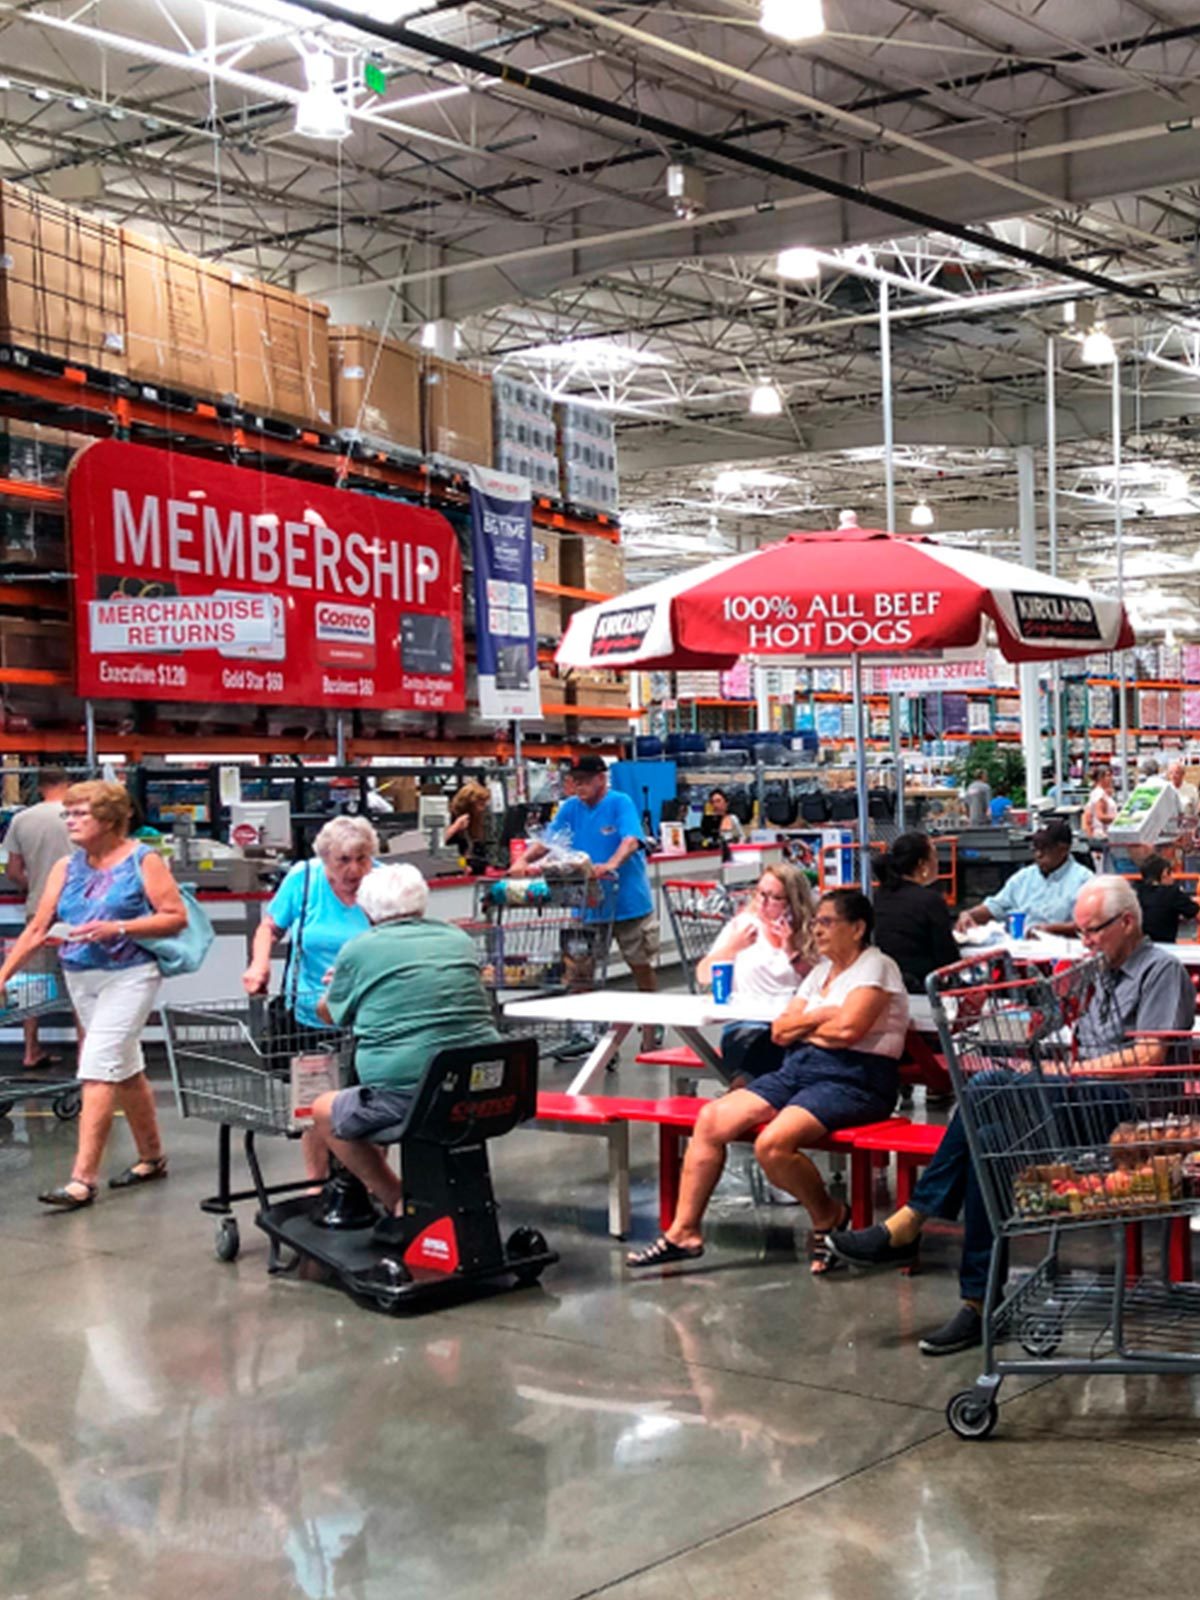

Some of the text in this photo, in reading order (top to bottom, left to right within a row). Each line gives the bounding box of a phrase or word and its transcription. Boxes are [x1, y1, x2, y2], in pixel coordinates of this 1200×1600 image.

[112, 488, 440, 605] MEMBERSHIP
[98, 599, 264, 625] MERCHANDISE
[722, 591, 941, 621] 100% ALL BEEF
[1016, 594, 1093, 623] KIRKLAND
[128, 622, 236, 645] RETURNS
[750, 620, 912, 648] HOT DOGS
[100, 661, 156, 686] Executive
[222, 668, 244, 690] Gold
[246, 670, 264, 691] Star
